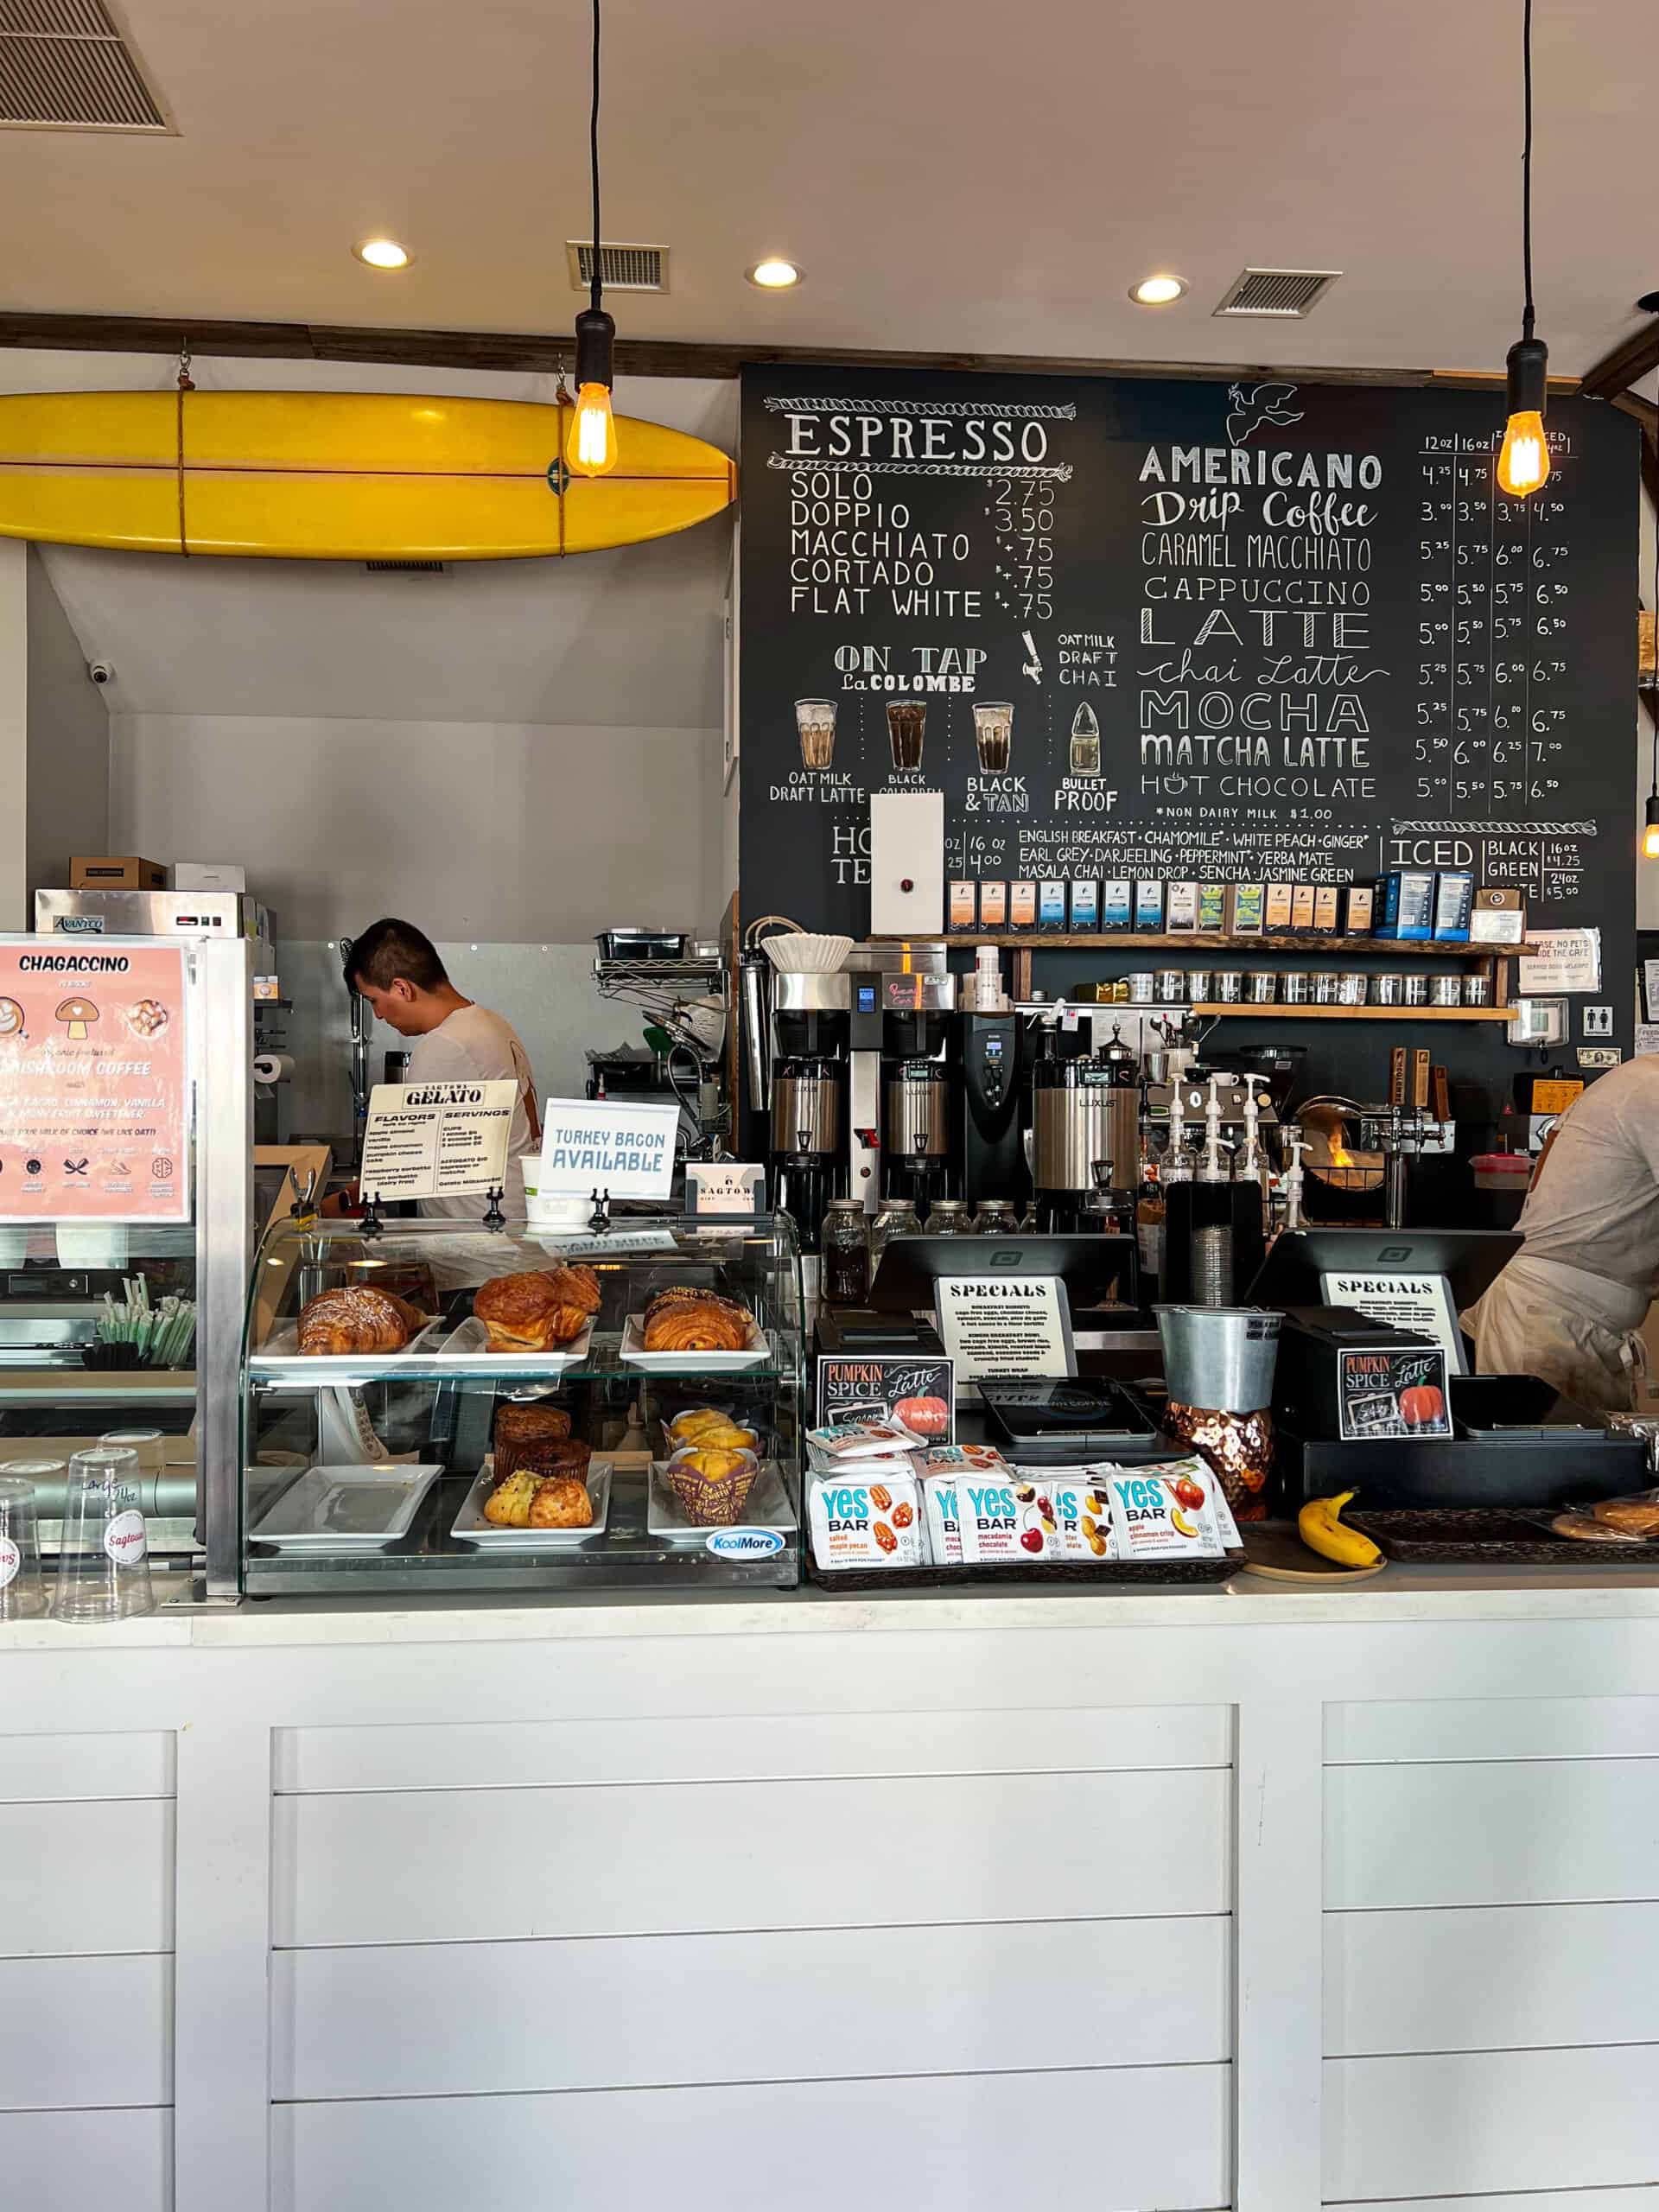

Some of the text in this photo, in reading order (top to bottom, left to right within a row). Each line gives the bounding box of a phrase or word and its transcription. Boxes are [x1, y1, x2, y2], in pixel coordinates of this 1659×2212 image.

[784, 414, 1048, 462] ESPRESSO
[1138, 445, 1382, 490] AMERICANO
[791, 472, 873, 500] SOLO
[791, 501, 910, 529] DOPPIO
[1141, 486, 1378, 536] Drip Coffee
[791, 530, 969, 561] MACCHIATO
[1141, 531, 1371, 572] CARAMEL MACCHIATO
[790, 558, 935, 586] CORTADO
[1144, 576, 1370, 606] CAPPUCCINO
[791, 586, 871, 614] FLAT
[891, 589, 982, 618] WHITE
[1141, 607, 1370, 649] LATTE
[834, 645, 988, 675] ON TAP
[1058, 650, 1118, 664] DRAFT
[1136, 648, 1390, 686] chai Latte
[841, 674, 976, 693] La COLOMBE
[1058, 669, 1117, 687] CHAI
[1140, 690, 1370, 733] MOCHA
[1141, 734, 1370, 768] MATCHA LATTE
[788, 771, 852, 785] OAT MILK
[888, 774, 926, 785] BLACK
[967, 776, 1027, 793] BLACK
[1062, 778, 1107, 791] BULLET
[1219, 776, 1376, 798] CHOCOLATE
[769, 785, 815, 802] DRAFT
[820, 787, 865, 804] LATTE
[964, 792, 1030, 813] & TAN
[1053, 791, 1118, 812] PROOF
[1199, 807, 1238, 818] DAIRY
[1247, 808, 1277, 819] MILK
[1290, 808, 1332, 820] $1.00
[991, 837, 1006, 851] OZ
[1018, 830, 1069, 843] ENGLISH
[1071, 830, 1137, 844] BREAKFAST
[1232, 832, 1273, 847] WHITE
[1275, 833, 1316, 848] PEACH
[1487, 840, 1539, 856] BLACK
[1020, 848, 1052, 862] EARL
[1056, 847, 1090, 862] GREY
[1094, 848, 1173, 863] DARJEELING
[1256, 851, 1296, 865] YERBA
[1299, 851, 1335, 866] MATE
[1389, 839, 1474, 867] ICED
[1018, 864, 1354, 882] MASALA CHAI LEMON DROP SENCHA JASMINE GREEN
[1487, 861, 1539, 878] GREEN
[54, 916, 103, 933] AVANTCO
[1556, 939, 1568, 948] NO
[1570, 939, 1589, 948] PETS
[19, 955, 130, 972] CHAGACCINO
[97, 1061, 152, 1076] COFFEE
[406, 1089, 481, 1105] GELATO
[374, 1113, 436, 1122] FLAVORS
[444, 1109, 511, 1119] SERVINGS
[556, 1128, 665, 1148] TURKEY BACON
[552, 1149, 664, 1172] AVAILABLE
[950, 1284, 1046, 1297] SPECIALS
[1337, 1281, 1433, 1294] SPECIALS
[828, 1363, 883, 1382] PUMPKIN
[1346, 1356, 1390, 1373] PUMPKIN
[1394, 1356, 1437, 1388] Latte
[827, 1382, 882, 1397] SPICE
[887, 1365, 944, 1398] Latte
[1345, 1373, 1390, 1389] SPICE
[977, 1518, 1017, 1530] BAR
[1126, 1508, 1166, 1522] BAR
[829, 1519, 869, 1531] BAR
[713, 1537, 772, 1549] KoolMore
